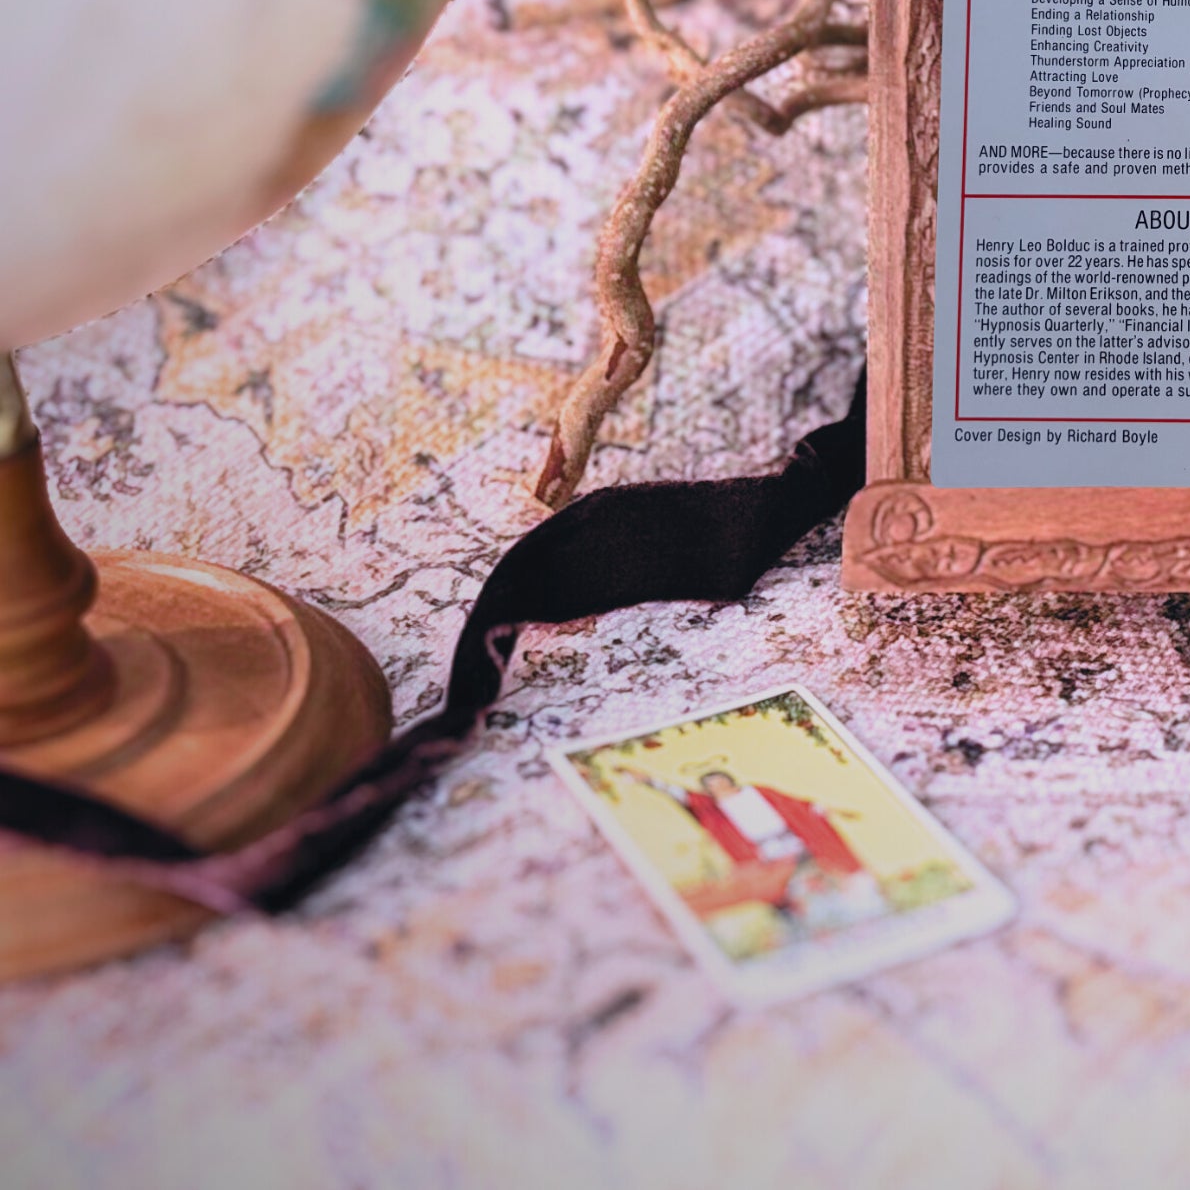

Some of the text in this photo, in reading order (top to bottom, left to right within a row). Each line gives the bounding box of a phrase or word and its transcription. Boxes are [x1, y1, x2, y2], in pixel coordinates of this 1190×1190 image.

[1031, 8, 1155, 24] Ending a Relationship
[1031, 23, 1147, 40] Finding Lost Objects
[1030, 39, 1149, 55] Enhancing Creativity
[1030, 55, 1185, 71] Thunderstorm Appreciation
[1029, 69, 1119, 85] Attracting Love
[1029, 85, 1072, 101] Beyond
[1076, 86, 1134, 98] Tomorrow
[1029, 100, 1165, 114] Friends and Soul Mates
[1028, 116, 1112, 131] Healing Sound
[978, 161, 1035, 177] provides
[1040, 164, 1048, 174] a
[1052, 161, 1080, 174] safe
[1084, 162, 1108, 174] and
[1113, 165, 1157, 177] proven
[973, 351, 1034, 366] Hypnosis
[1038, 351, 1080, 364] Center
[1084, 352, 1095, 364] in
[1099, 352, 1139, 364] Rhode
[1142, 352, 1185, 367] Island,
[954, 429, 1158, 446] Cover Design by Richard Boyle
